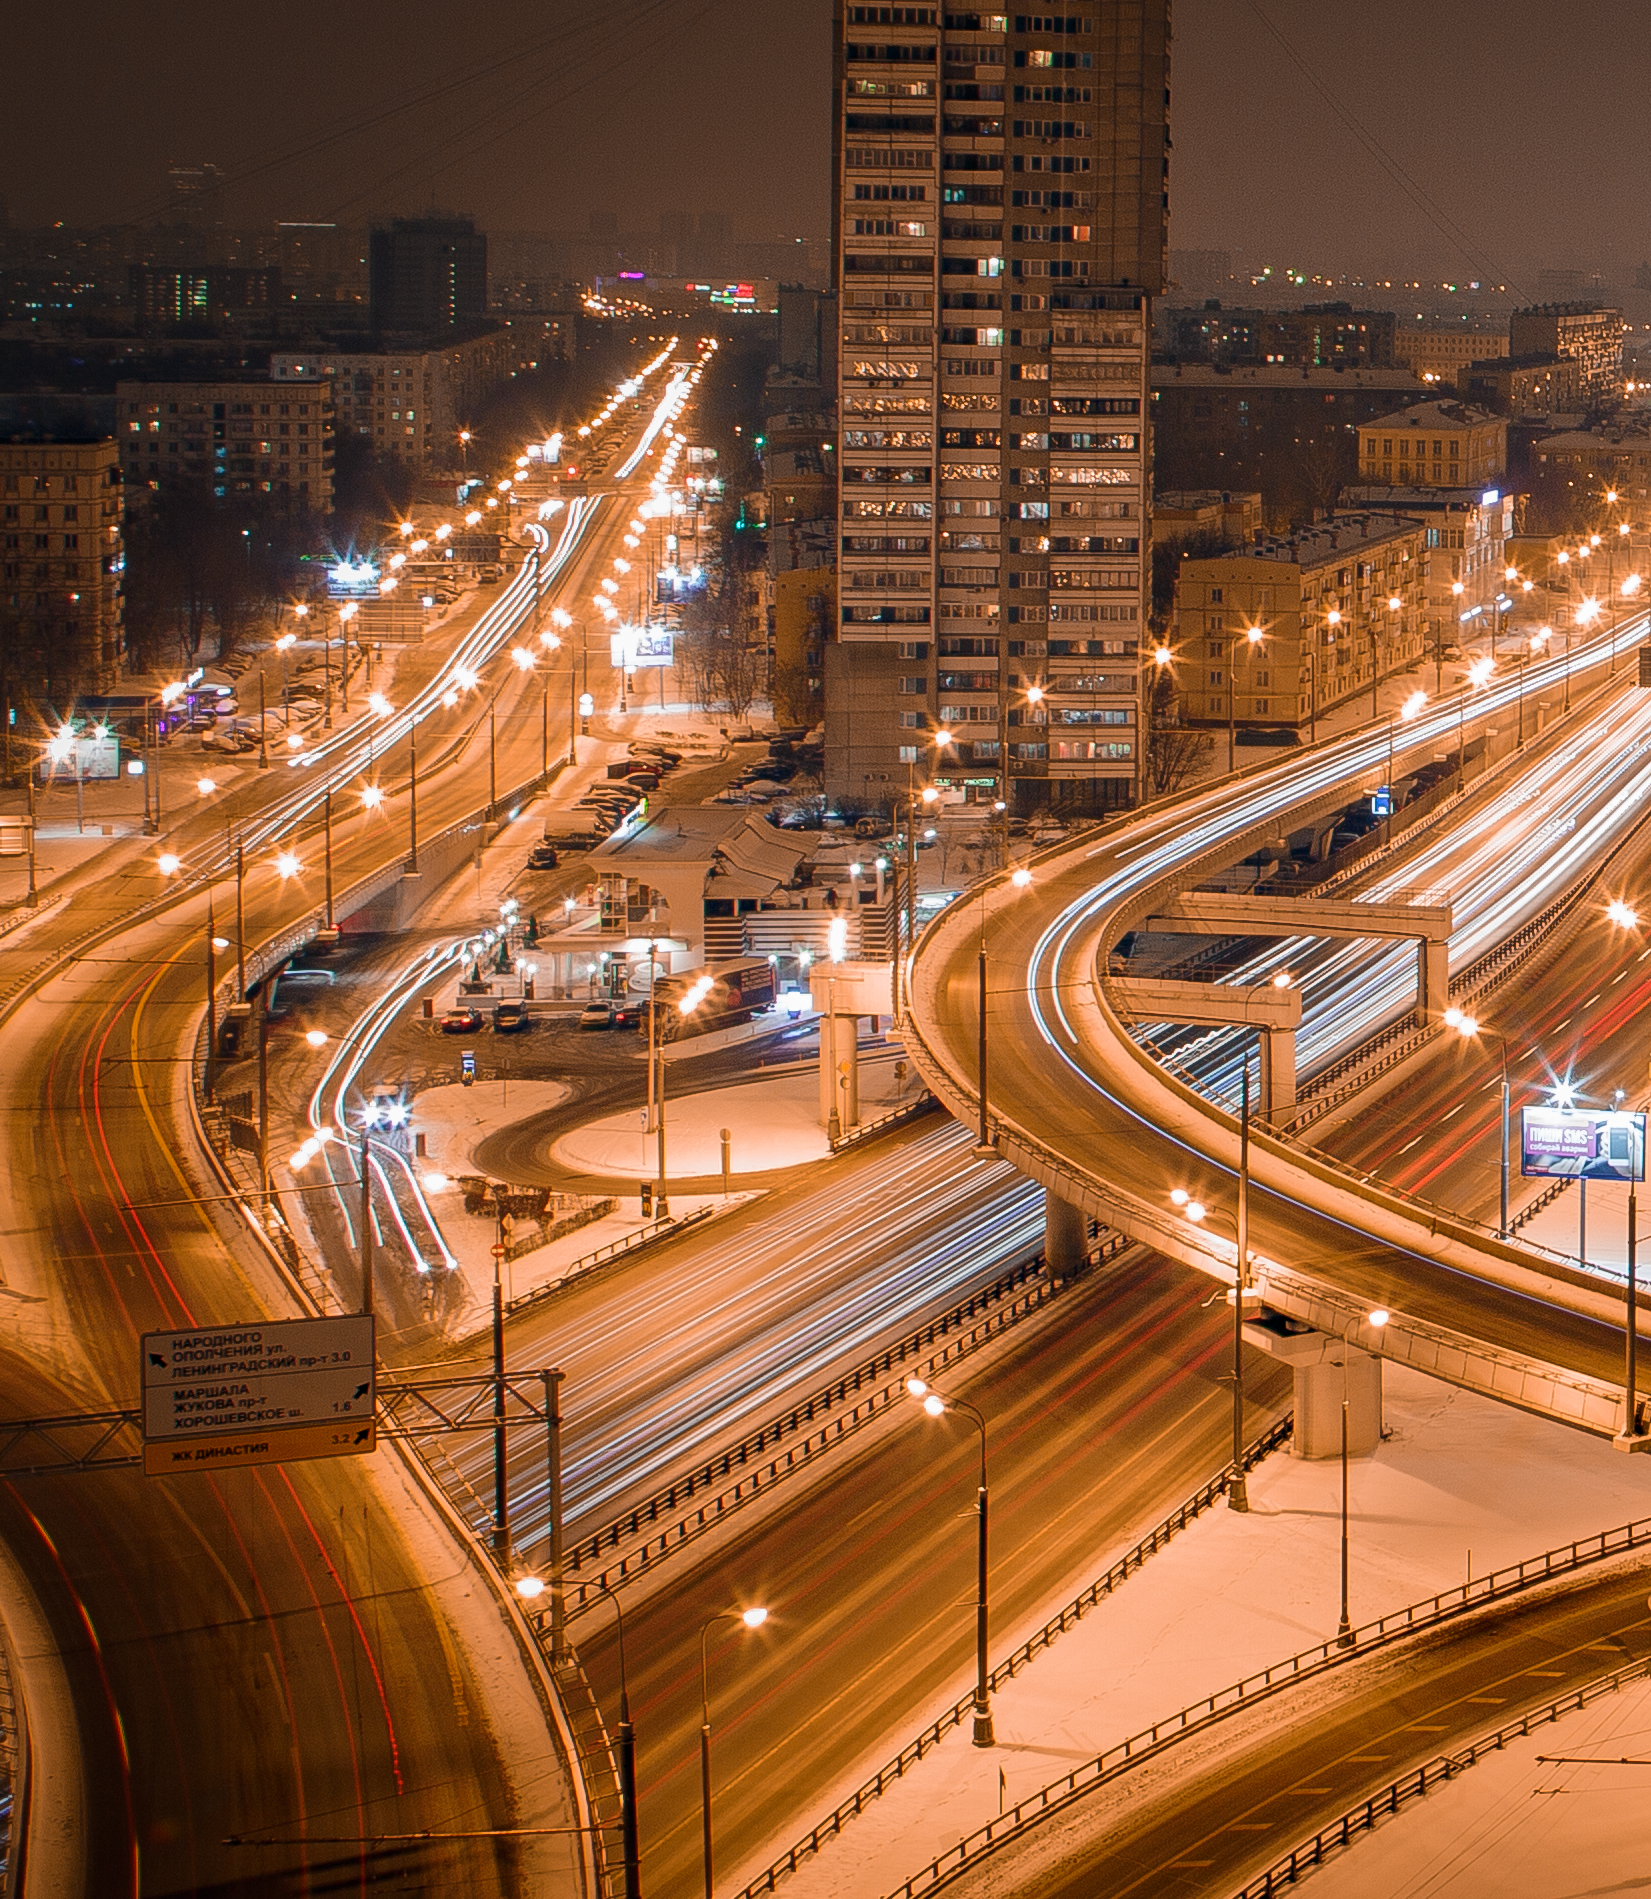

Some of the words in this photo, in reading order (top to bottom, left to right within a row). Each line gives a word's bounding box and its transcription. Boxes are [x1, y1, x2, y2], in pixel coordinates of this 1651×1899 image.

[172, 1332, 262, 1350] НАРОДНОГО
[172, 1344, 263, 1362] ОПОЛЧЕНИЯ
[266, 1345, 287, 1356] ул.
[171, 1355, 295, 1378] ЛЕНИНГРАДСКИЙ
[300, 1355, 328, 1367] пр-т
[331, 1351, 351, 1363] 3.0
[173, 1384, 250, 1400] МАРШАЛА
[173, 1398, 235, 1414] ЖУКОВА
[238, 1396, 268, 1408] пр-т
[174, 1408, 286, 1429] ХОРОШЕВСКОЕ
[172, 1449, 193, 1461] ЖК
[195, 1442, 270, 1460] ДИНАСТИЯ
